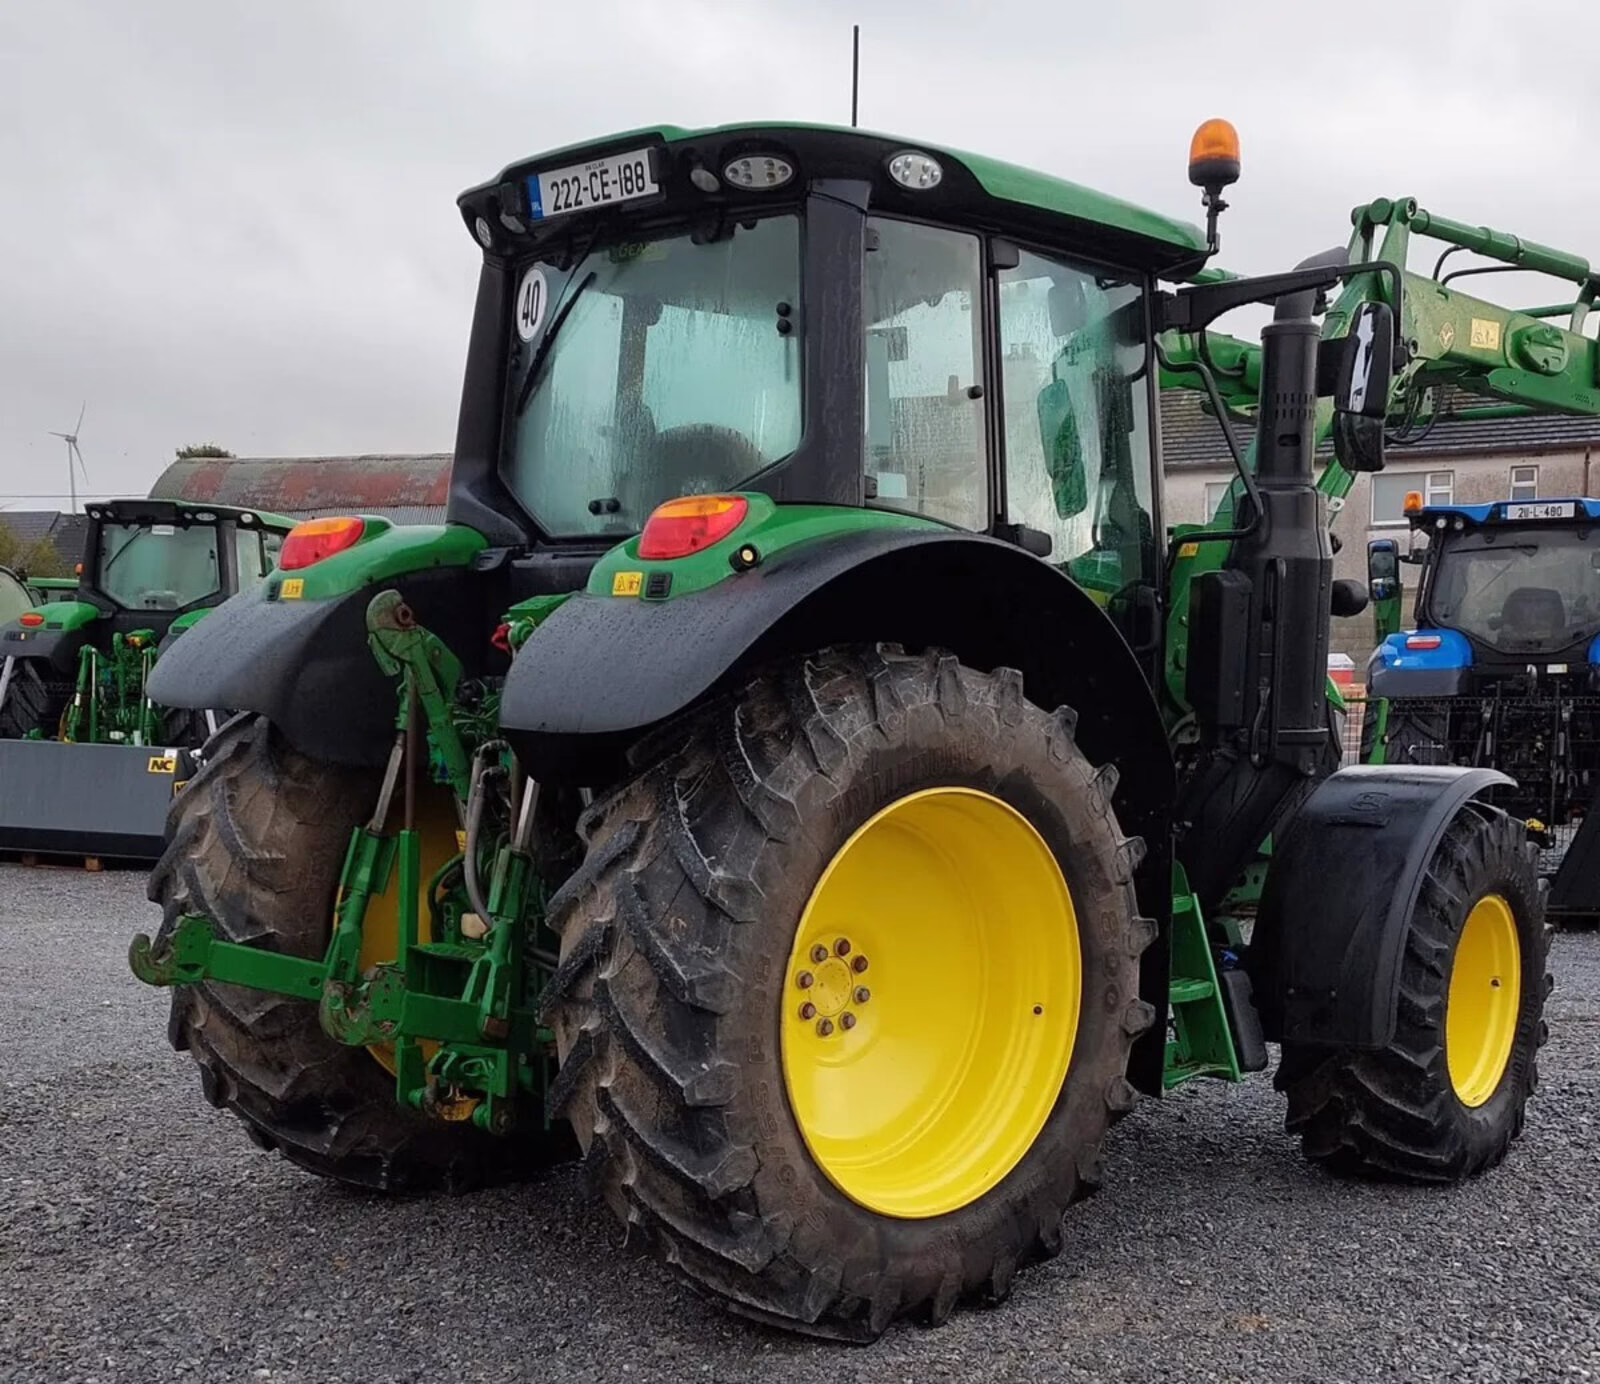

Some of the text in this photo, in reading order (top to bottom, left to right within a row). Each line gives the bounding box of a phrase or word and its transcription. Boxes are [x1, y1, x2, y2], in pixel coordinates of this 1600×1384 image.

[550, 161, 646, 212] 222-CE-188
[522, 279, 541, 328] 40
[151, 760, 173, 770] NC
